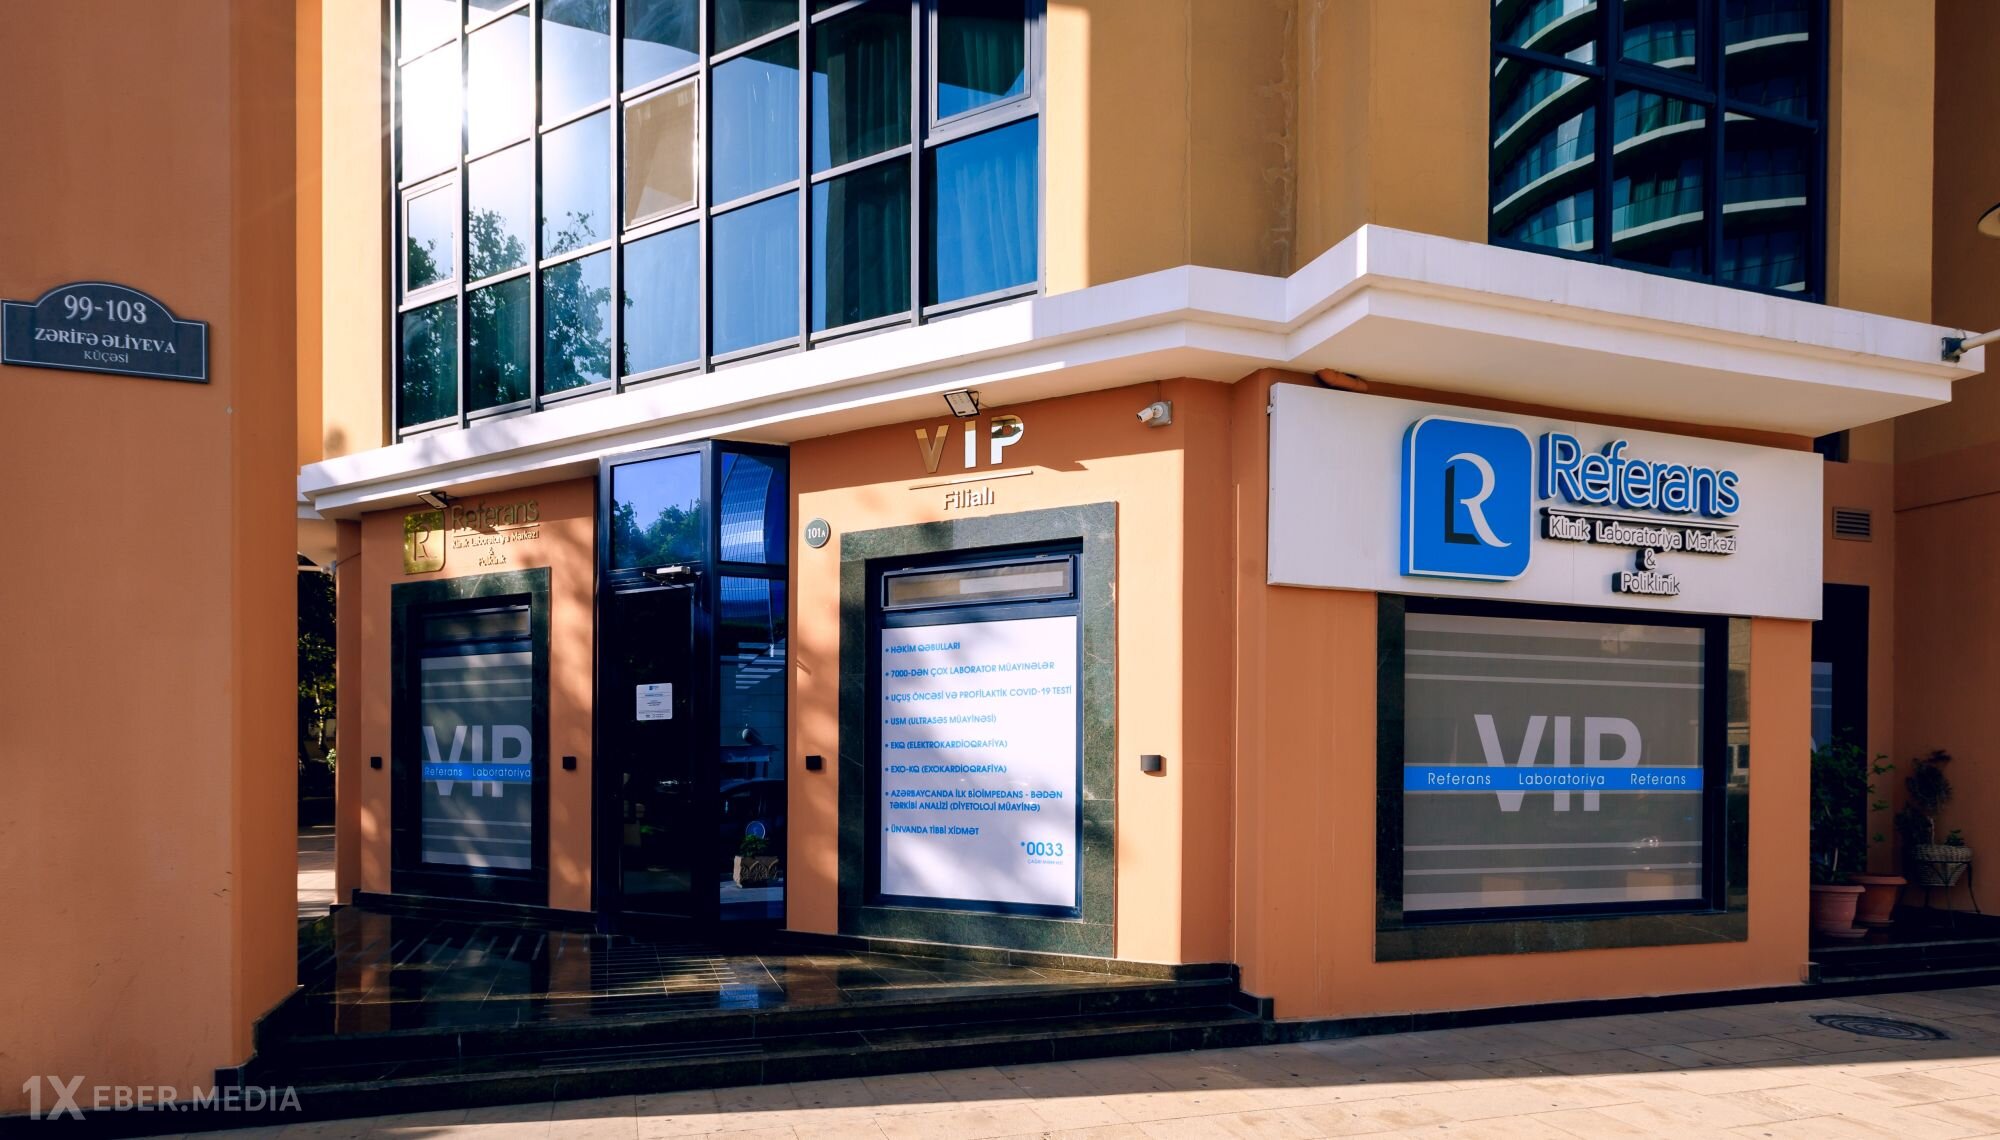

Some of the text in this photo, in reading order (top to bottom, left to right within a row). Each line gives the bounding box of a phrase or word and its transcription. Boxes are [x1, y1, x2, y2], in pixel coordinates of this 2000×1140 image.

[63, 294, 147, 324] 99-103
[34, 327, 176, 354] ZƏRİFƏ ƏLİYEVA
[915, 414, 1024, 474] VIP
[1547, 430, 1741, 517] Referans
[1549, 515, 1737, 553] Klinik Laboratoriya Mərkəzi
[1643, 548, 1657, 569] &
[1621, 571, 1681, 595] Poliklinik
[890, 641, 961, 654] HƏKİM QƏBULLARI
[891, 668, 929, 678] 7000-DƏN
[930, 667, 948, 677] ÇOX
[950, 663, 997, 675] LABORATOR
[912, 689, 944, 701] ÖNCƏSİ
[945, 689, 958, 699] VƏ
[959, 687, 1008, 699] PROFİLAKTİK
[1009, 686, 1051, 697] COVID-19
[1052, 684, 1072, 695] TESTİ
[890, 717, 907, 726] USM
[423, 724, 532, 798] VIP
[1474, 713, 1642, 812] VIP
[424, 766, 531, 778] Referans Laboratoriya
[1427, 772, 1686, 787] Referans Laboratoriya Referans
[890, 789, 954, 798] AZƏRBAYCANDA
[955, 788, 966, 798] İLK
[1030, 790, 1063, 799] BƏDƏN
[889, 800, 1041, 812] TƏRKİBİ ANALİZİ (DİYETOLOJİ MÜAYİNƏ)
[890, 824, 979, 835] ÜNVANDA TİBBİ XİDMƏT
